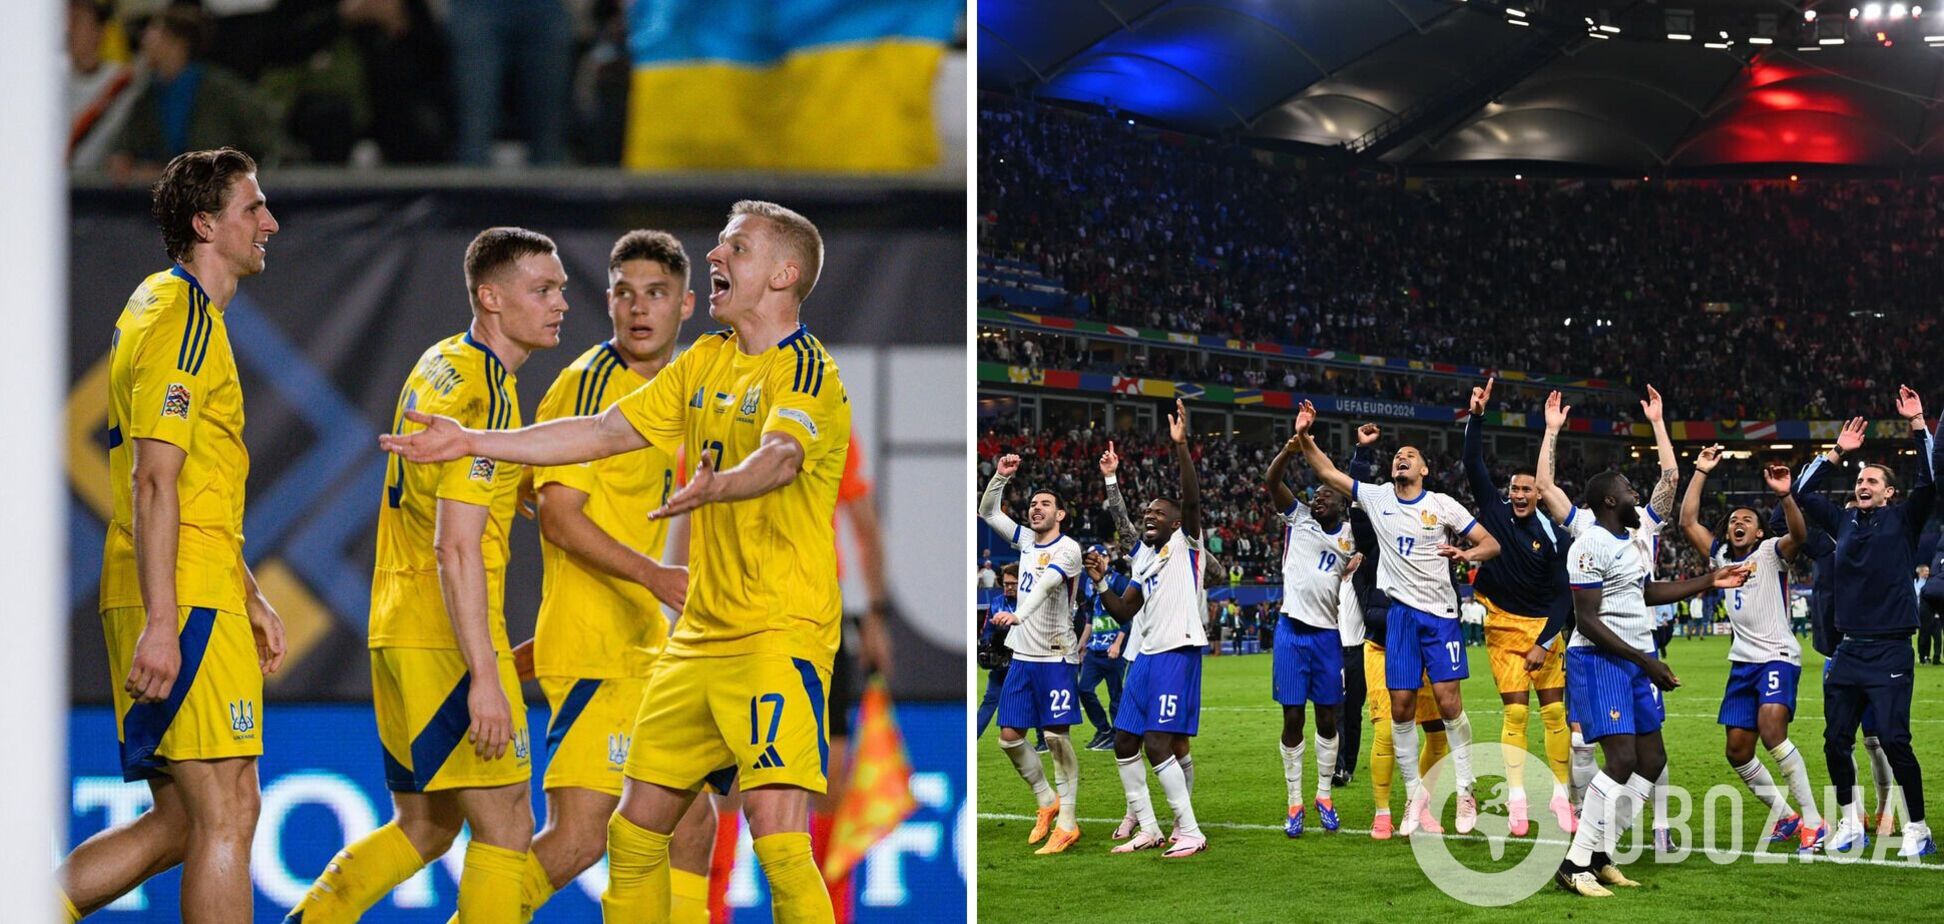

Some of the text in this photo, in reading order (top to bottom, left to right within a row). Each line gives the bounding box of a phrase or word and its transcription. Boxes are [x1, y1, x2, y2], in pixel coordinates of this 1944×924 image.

[1396, 535, 1415, 556] 17
[1317, 550, 1337, 573] 19
[1020, 570, 1034, 593] 22
[1734, 589, 1743, 610] 5
[1445, 641, 1461, 663] 17
[1768, 670, 1779, 690] 5
[1049, 689, 1072, 712] 22
[1158, 694, 1179, 718] 15
[750, 692, 785, 745] 17
